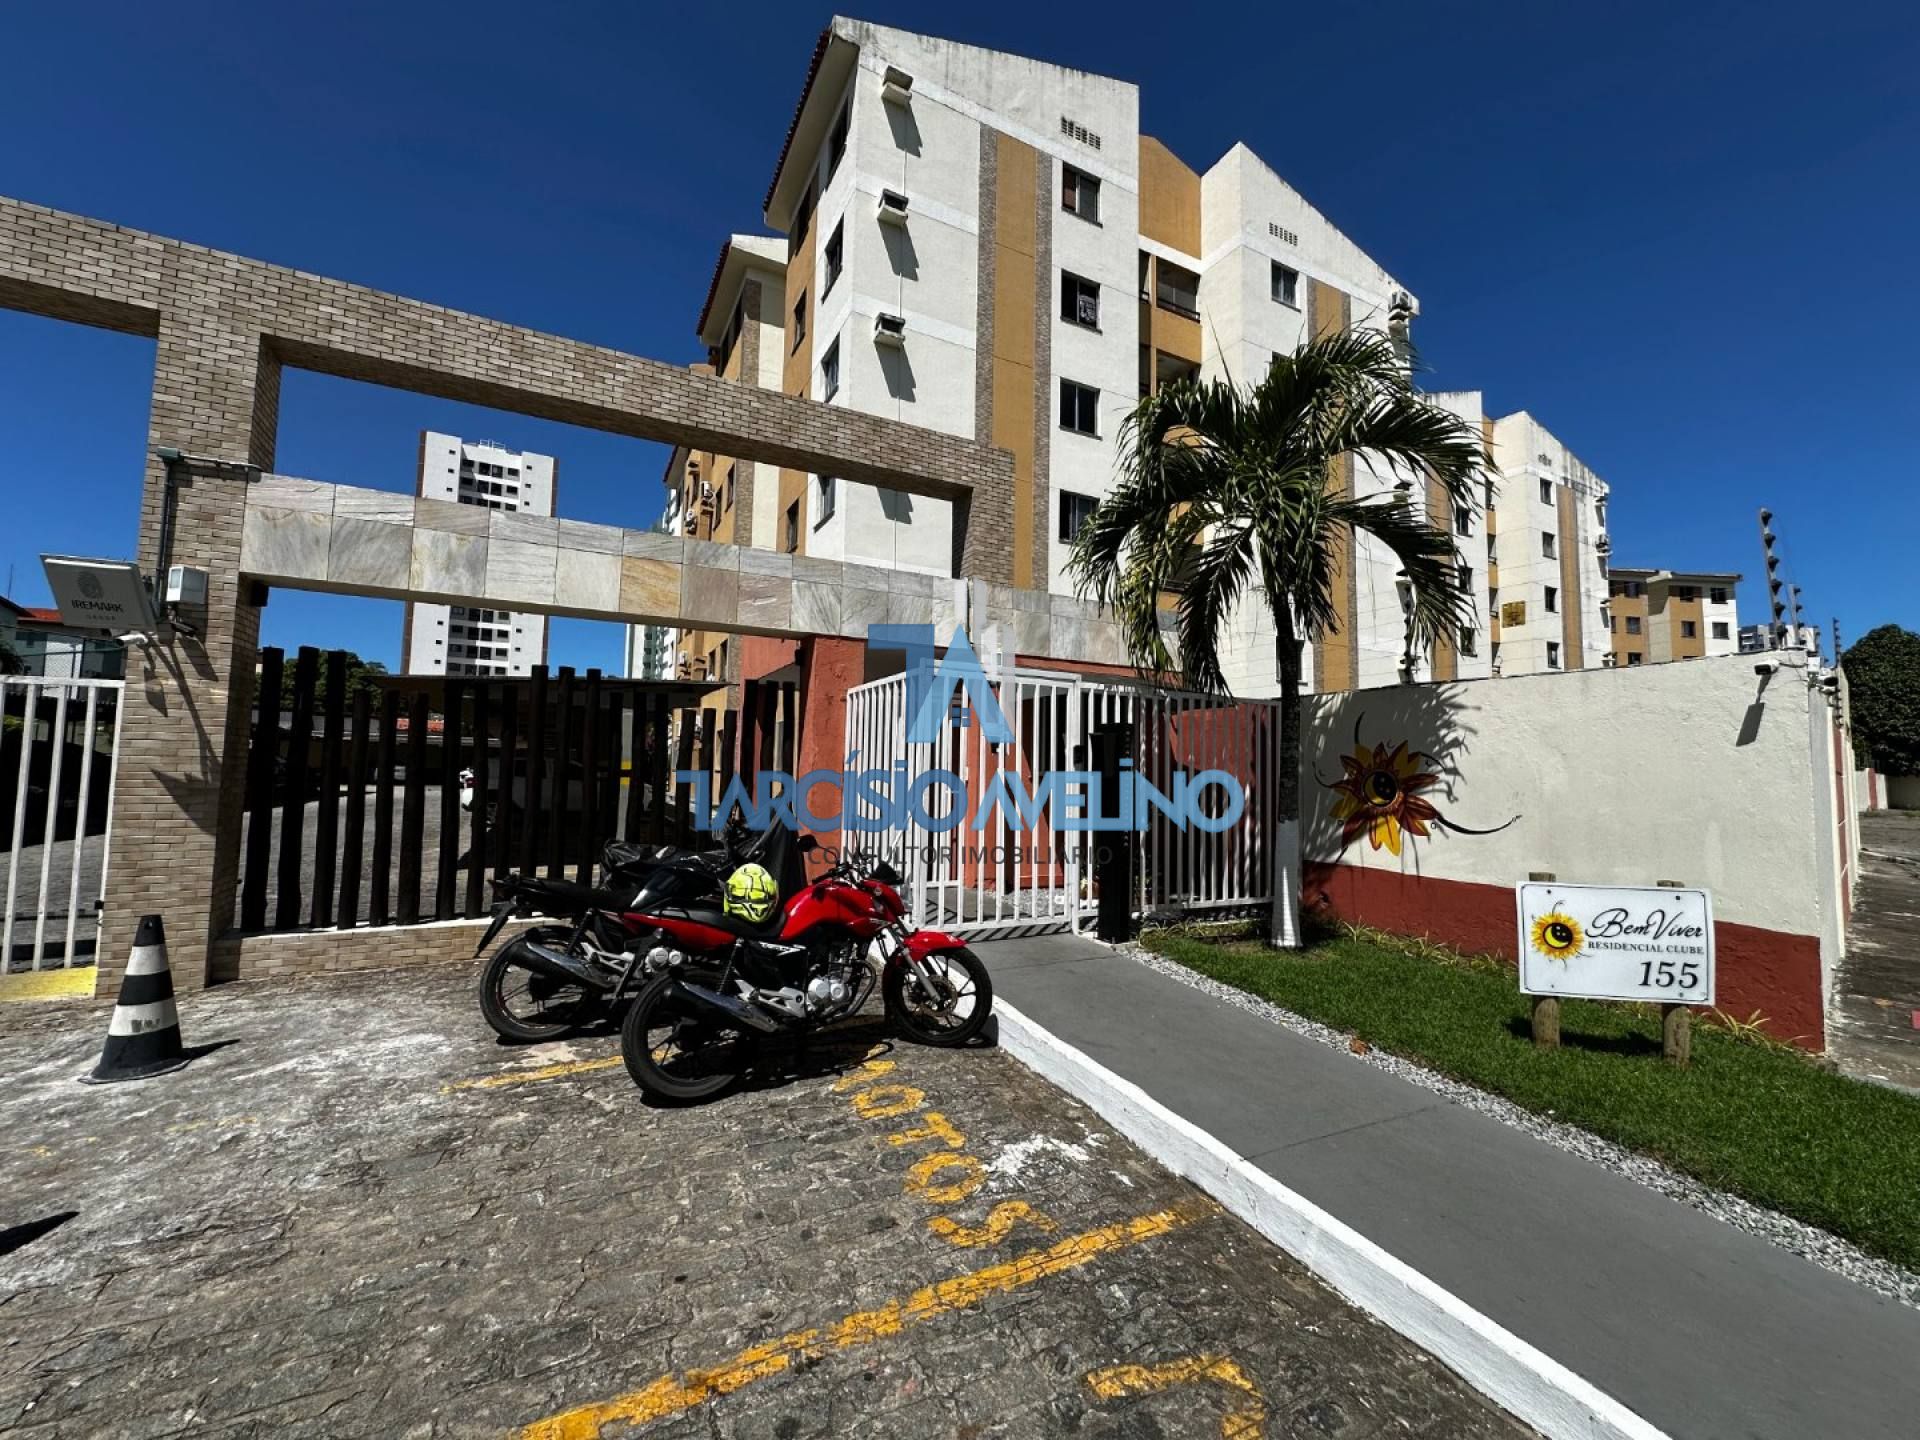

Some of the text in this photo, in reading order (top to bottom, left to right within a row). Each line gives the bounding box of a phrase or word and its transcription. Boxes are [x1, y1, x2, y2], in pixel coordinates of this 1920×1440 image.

[1585, 907, 1703, 940] Bem Viver
[1588, 940, 1704, 955] RESIDENCIAL CLUBE
[1638, 961, 1699, 989] 155
